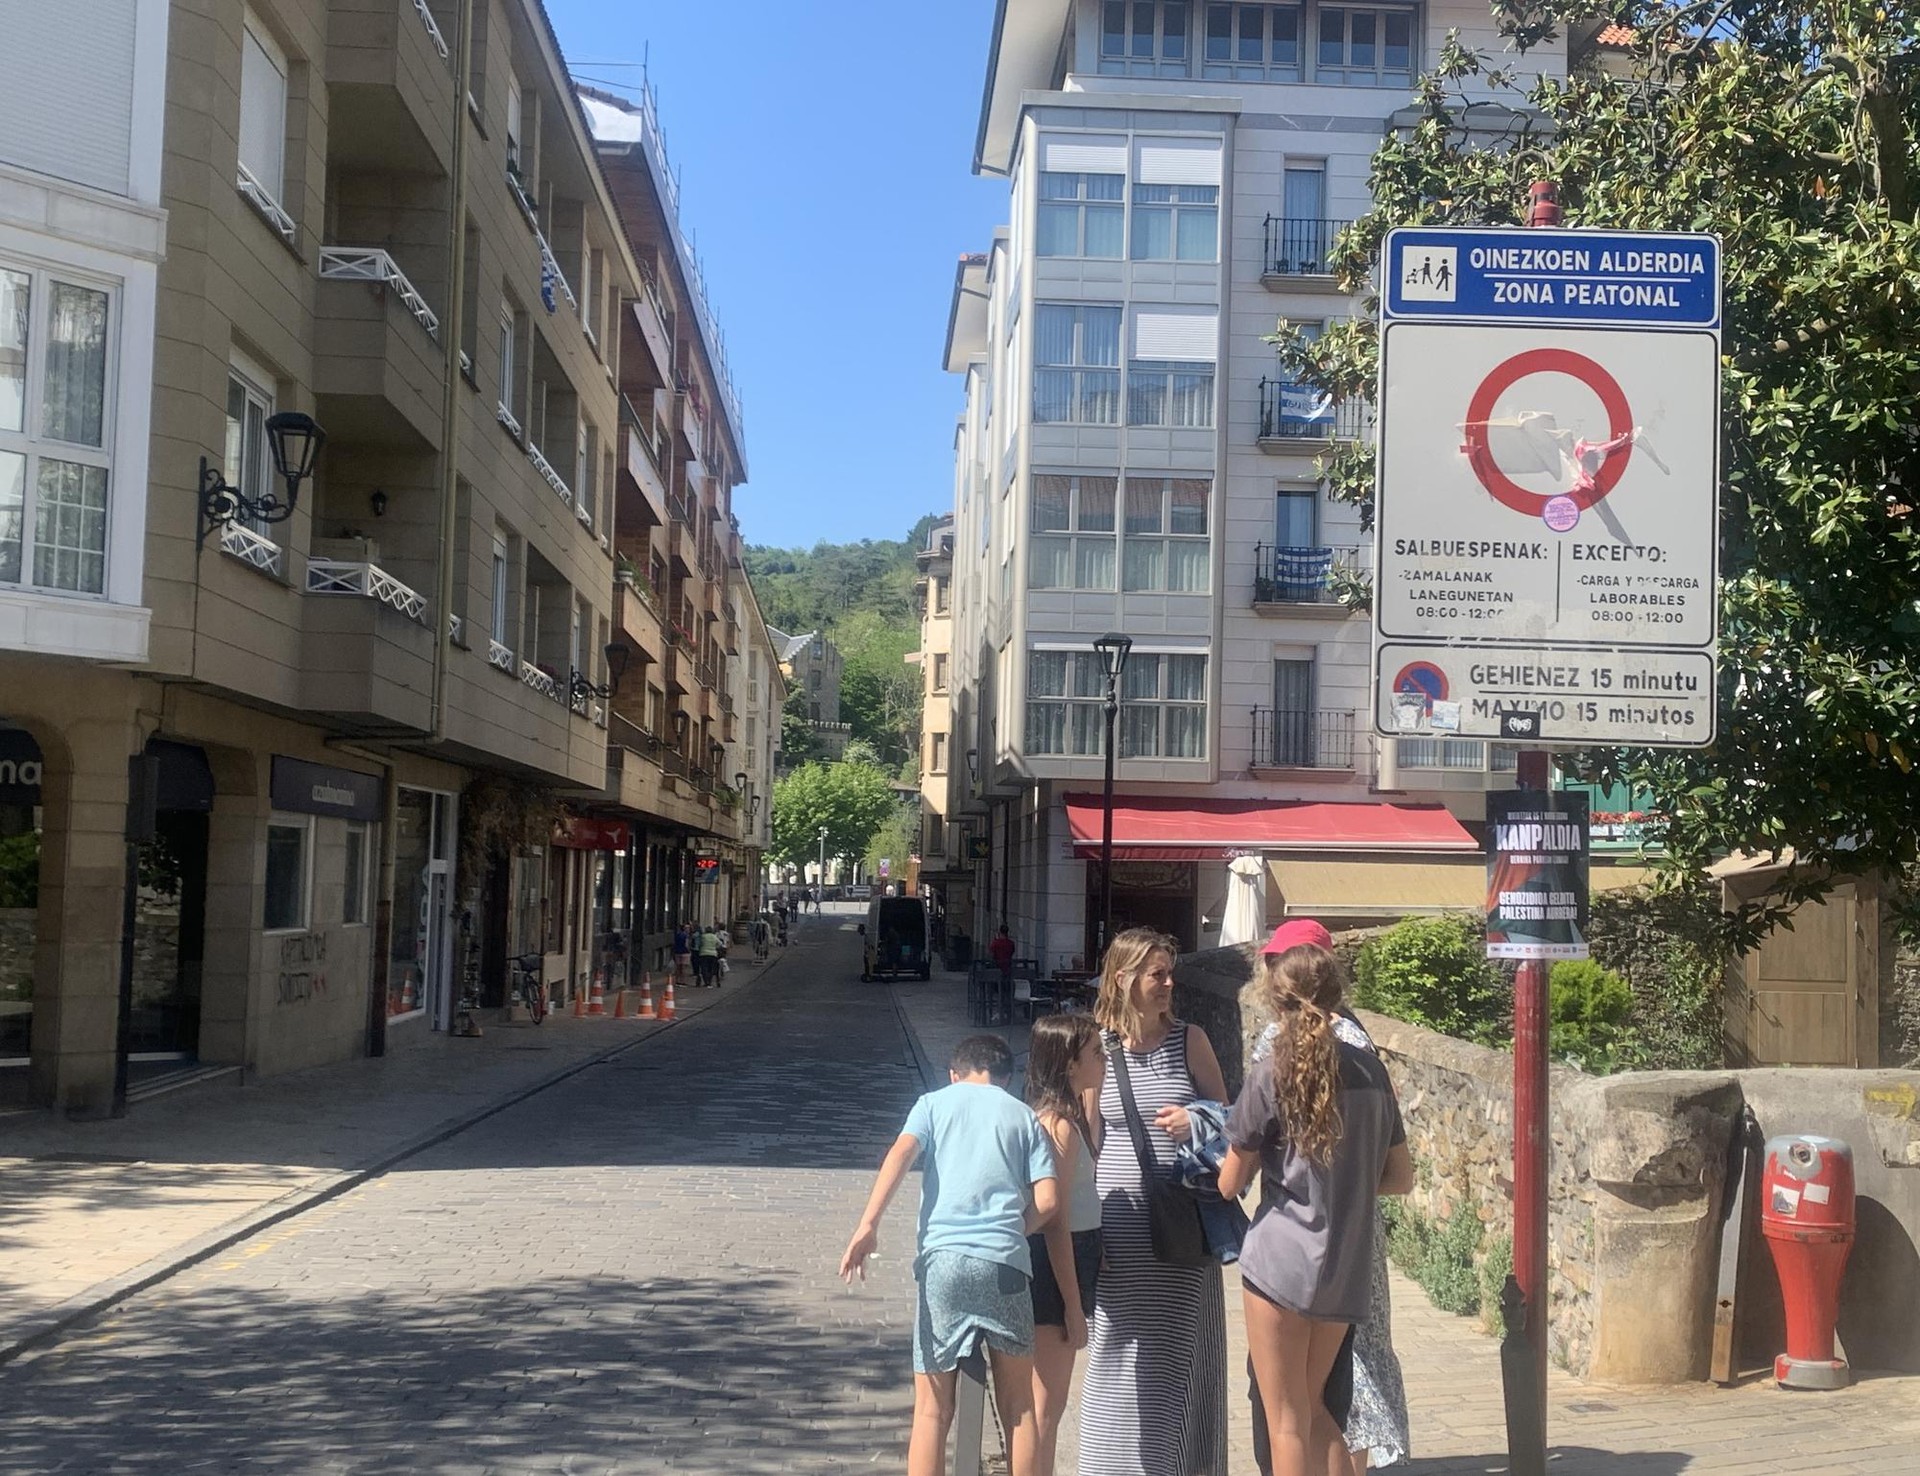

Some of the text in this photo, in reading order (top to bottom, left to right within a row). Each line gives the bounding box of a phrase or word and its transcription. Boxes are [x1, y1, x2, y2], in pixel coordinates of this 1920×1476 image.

[1469, 247, 1705, 275] OINEZKOEN ALDERDIA
[1493, 282, 1681, 308] ZONA PEATONAL
[1394, 538, 1549, 560] SALBUESPENAK:
[1625, 576, 1632, 587] Y
[1637, 576, 1700, 589] SCARGA
[1409, 588, 1514, 603] LANEGUNETAN
[1590, 592, 1686, 606] LABORABLES
[1416, 606, 1458, 618] 08:00
[1591, 609, 1634, 622] 08:00
[1646, 611, 1684, 624] 12:00
[1470, 663, 1698, 692] GEHIENEZ 15 minutu
[1577, 701, 1598, 722] 15
[1609, 703, 1695, 726] minutos
[1495, 824, 1582, 851] KANPALDIA
[1499, 905, 1545, 920] PALESTINA
